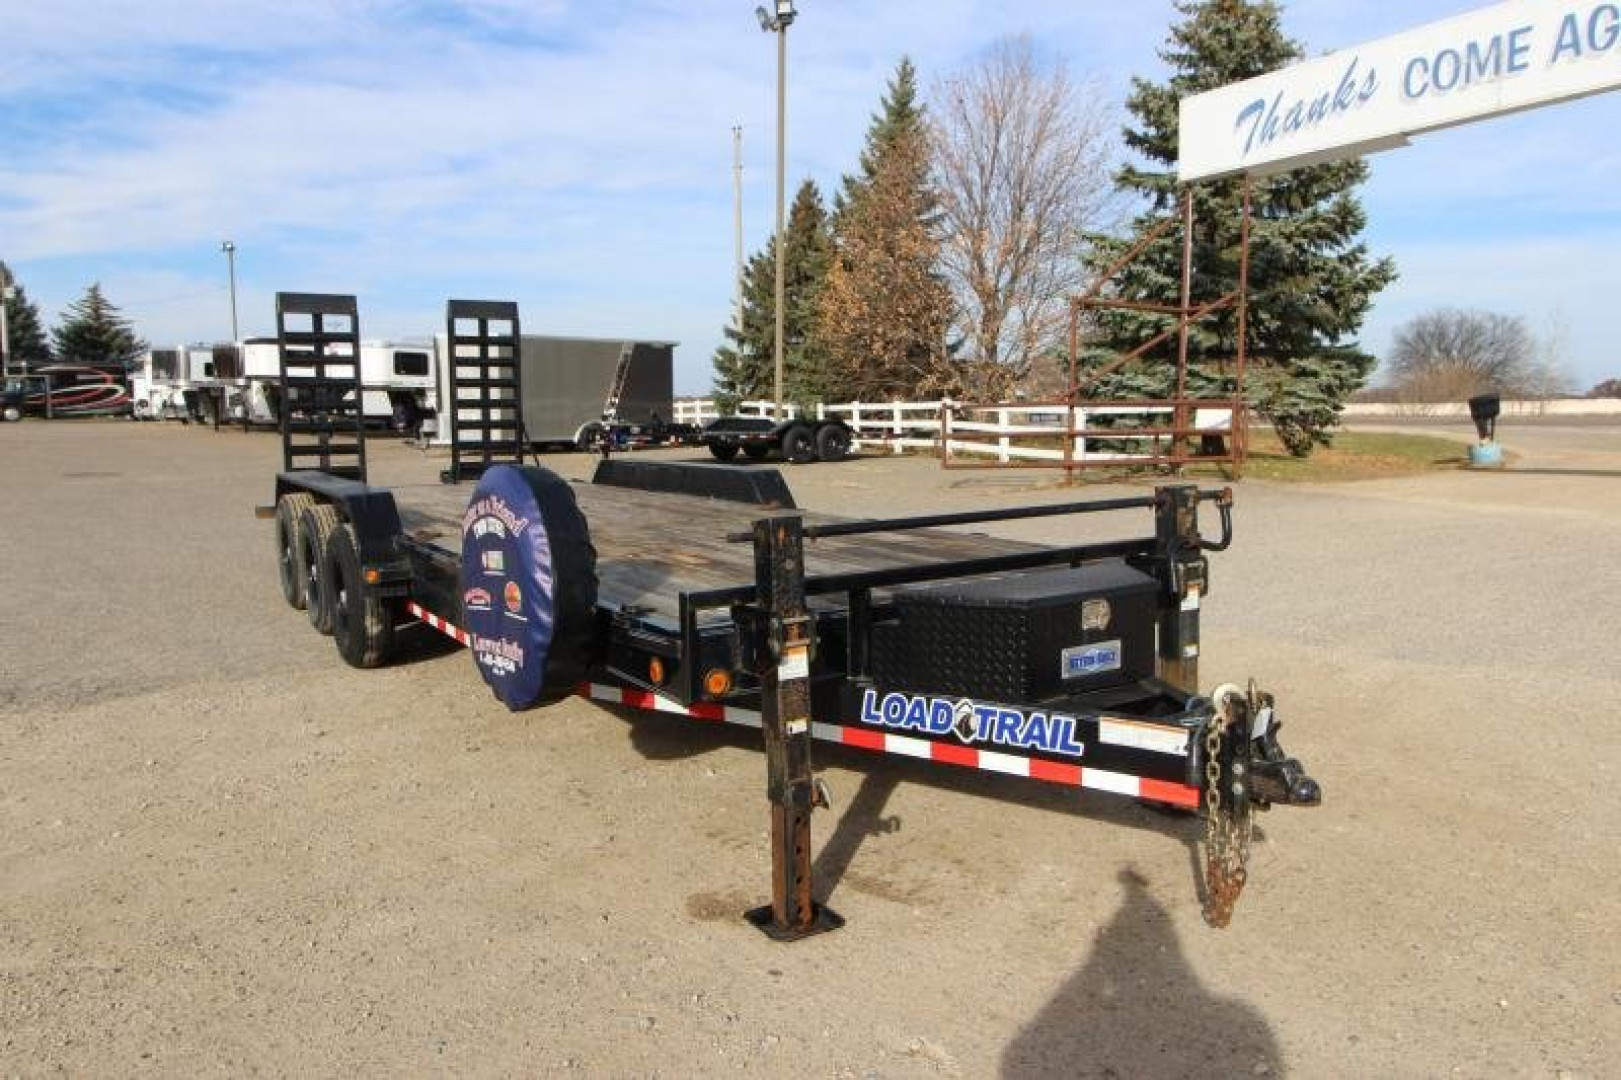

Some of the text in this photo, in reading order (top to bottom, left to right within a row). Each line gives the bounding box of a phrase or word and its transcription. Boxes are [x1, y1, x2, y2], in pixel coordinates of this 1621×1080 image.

[1235, 4, 1621, 156] Thanks COME AG
[861, 689, 955, 735] LOAD
[973, 707, 1084, 756] TRAIL
